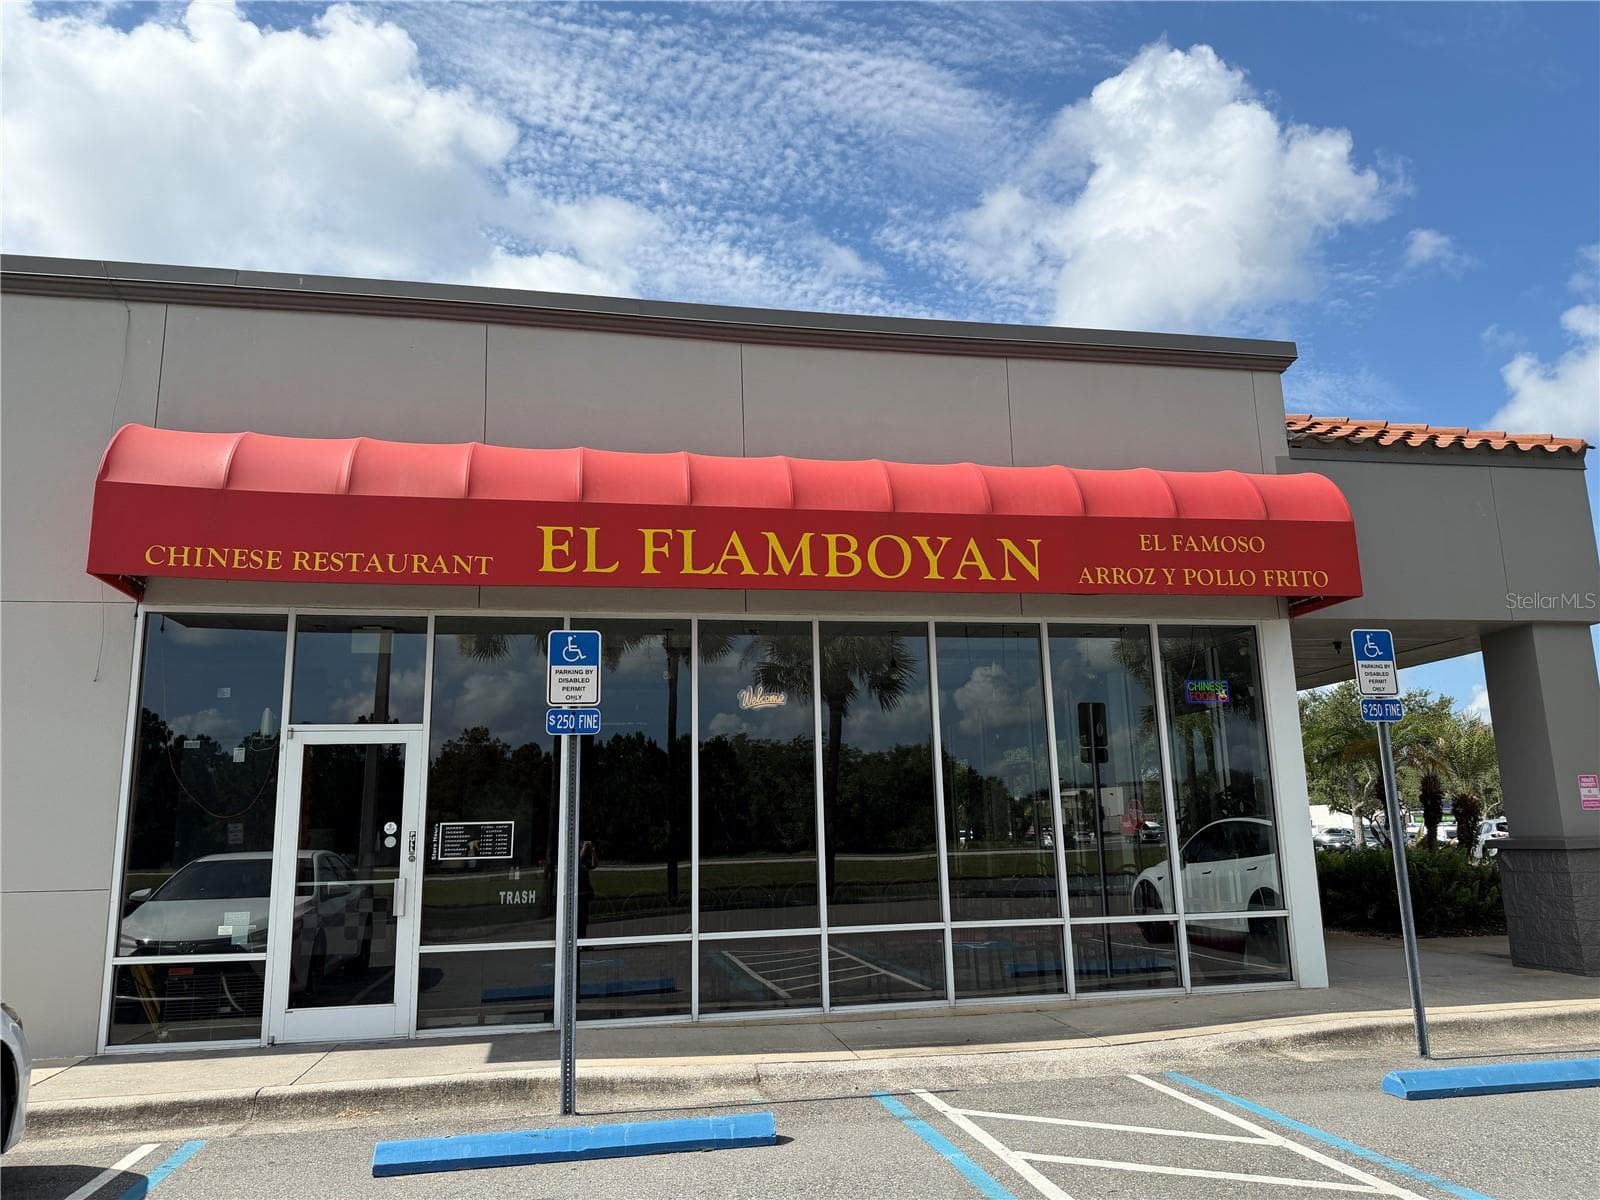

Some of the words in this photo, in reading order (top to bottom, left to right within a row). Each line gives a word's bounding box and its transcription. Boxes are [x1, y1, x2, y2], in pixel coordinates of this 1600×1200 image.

[536, 525, 620, 573] EL
[637, 528, 1042, 581] FLAMBOYAN
[1139, 533, 1166, 552] EL
[1171, 534, 1266, 553] FAMOSO
[144, 544, 283, 570] CHINESE
[292, 551, 495, 576] RESTAURANT
[1079, 566, 1157, 586] ARROZ
[1161, 568, 1177, 586] Y
[1183, 568, 1257, 587] POLLO
[1263, 569, 1330, 588] FRITO
[740, 685, 786, 708] Welcome
[1187, 681, 1228, 692] CHINESE
[1362, 703, 1383, 717] $250
[1385, 703, 1401, 717] FINE
[548, 714, 576, 730] $250
[578, 714, 599, 729] FINE
[498, 889, 537, 905] TRASH
